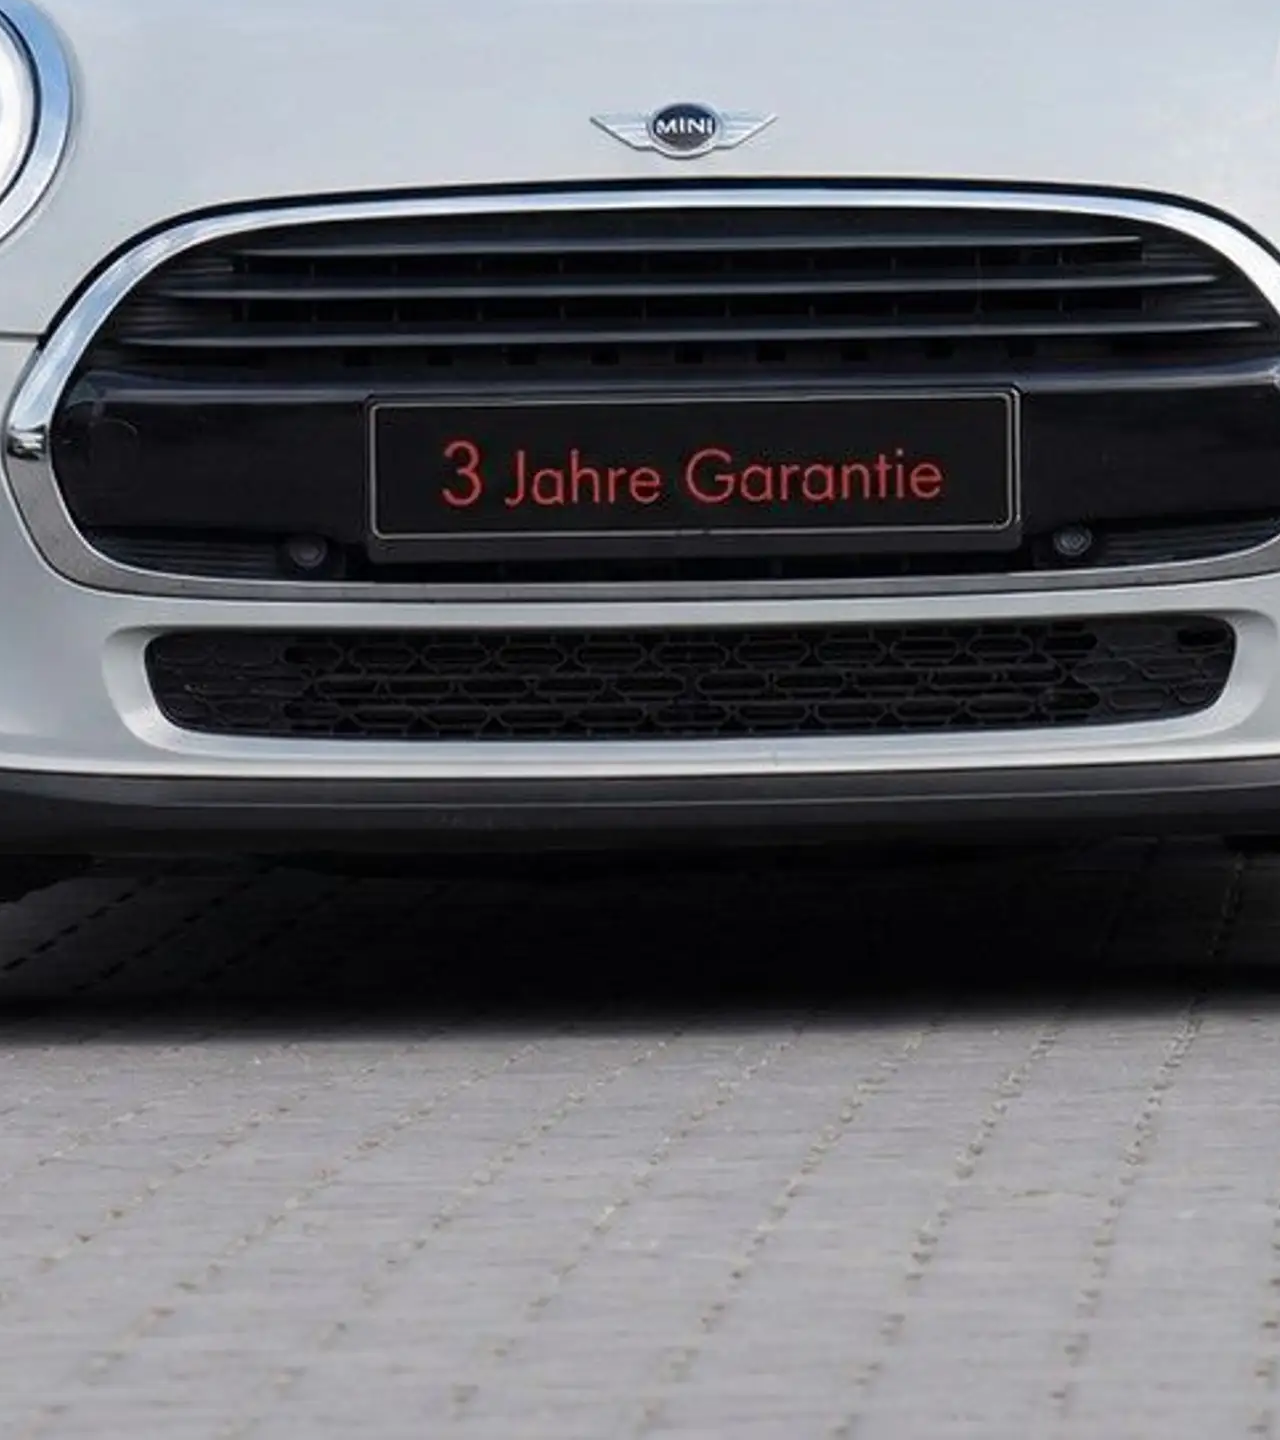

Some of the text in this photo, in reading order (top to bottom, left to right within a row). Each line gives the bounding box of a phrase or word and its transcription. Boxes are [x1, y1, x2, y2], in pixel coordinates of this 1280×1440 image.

[656, 118, 713, 135] MINI
[440, 440, 944, 508] 3 Jahre Garantie
